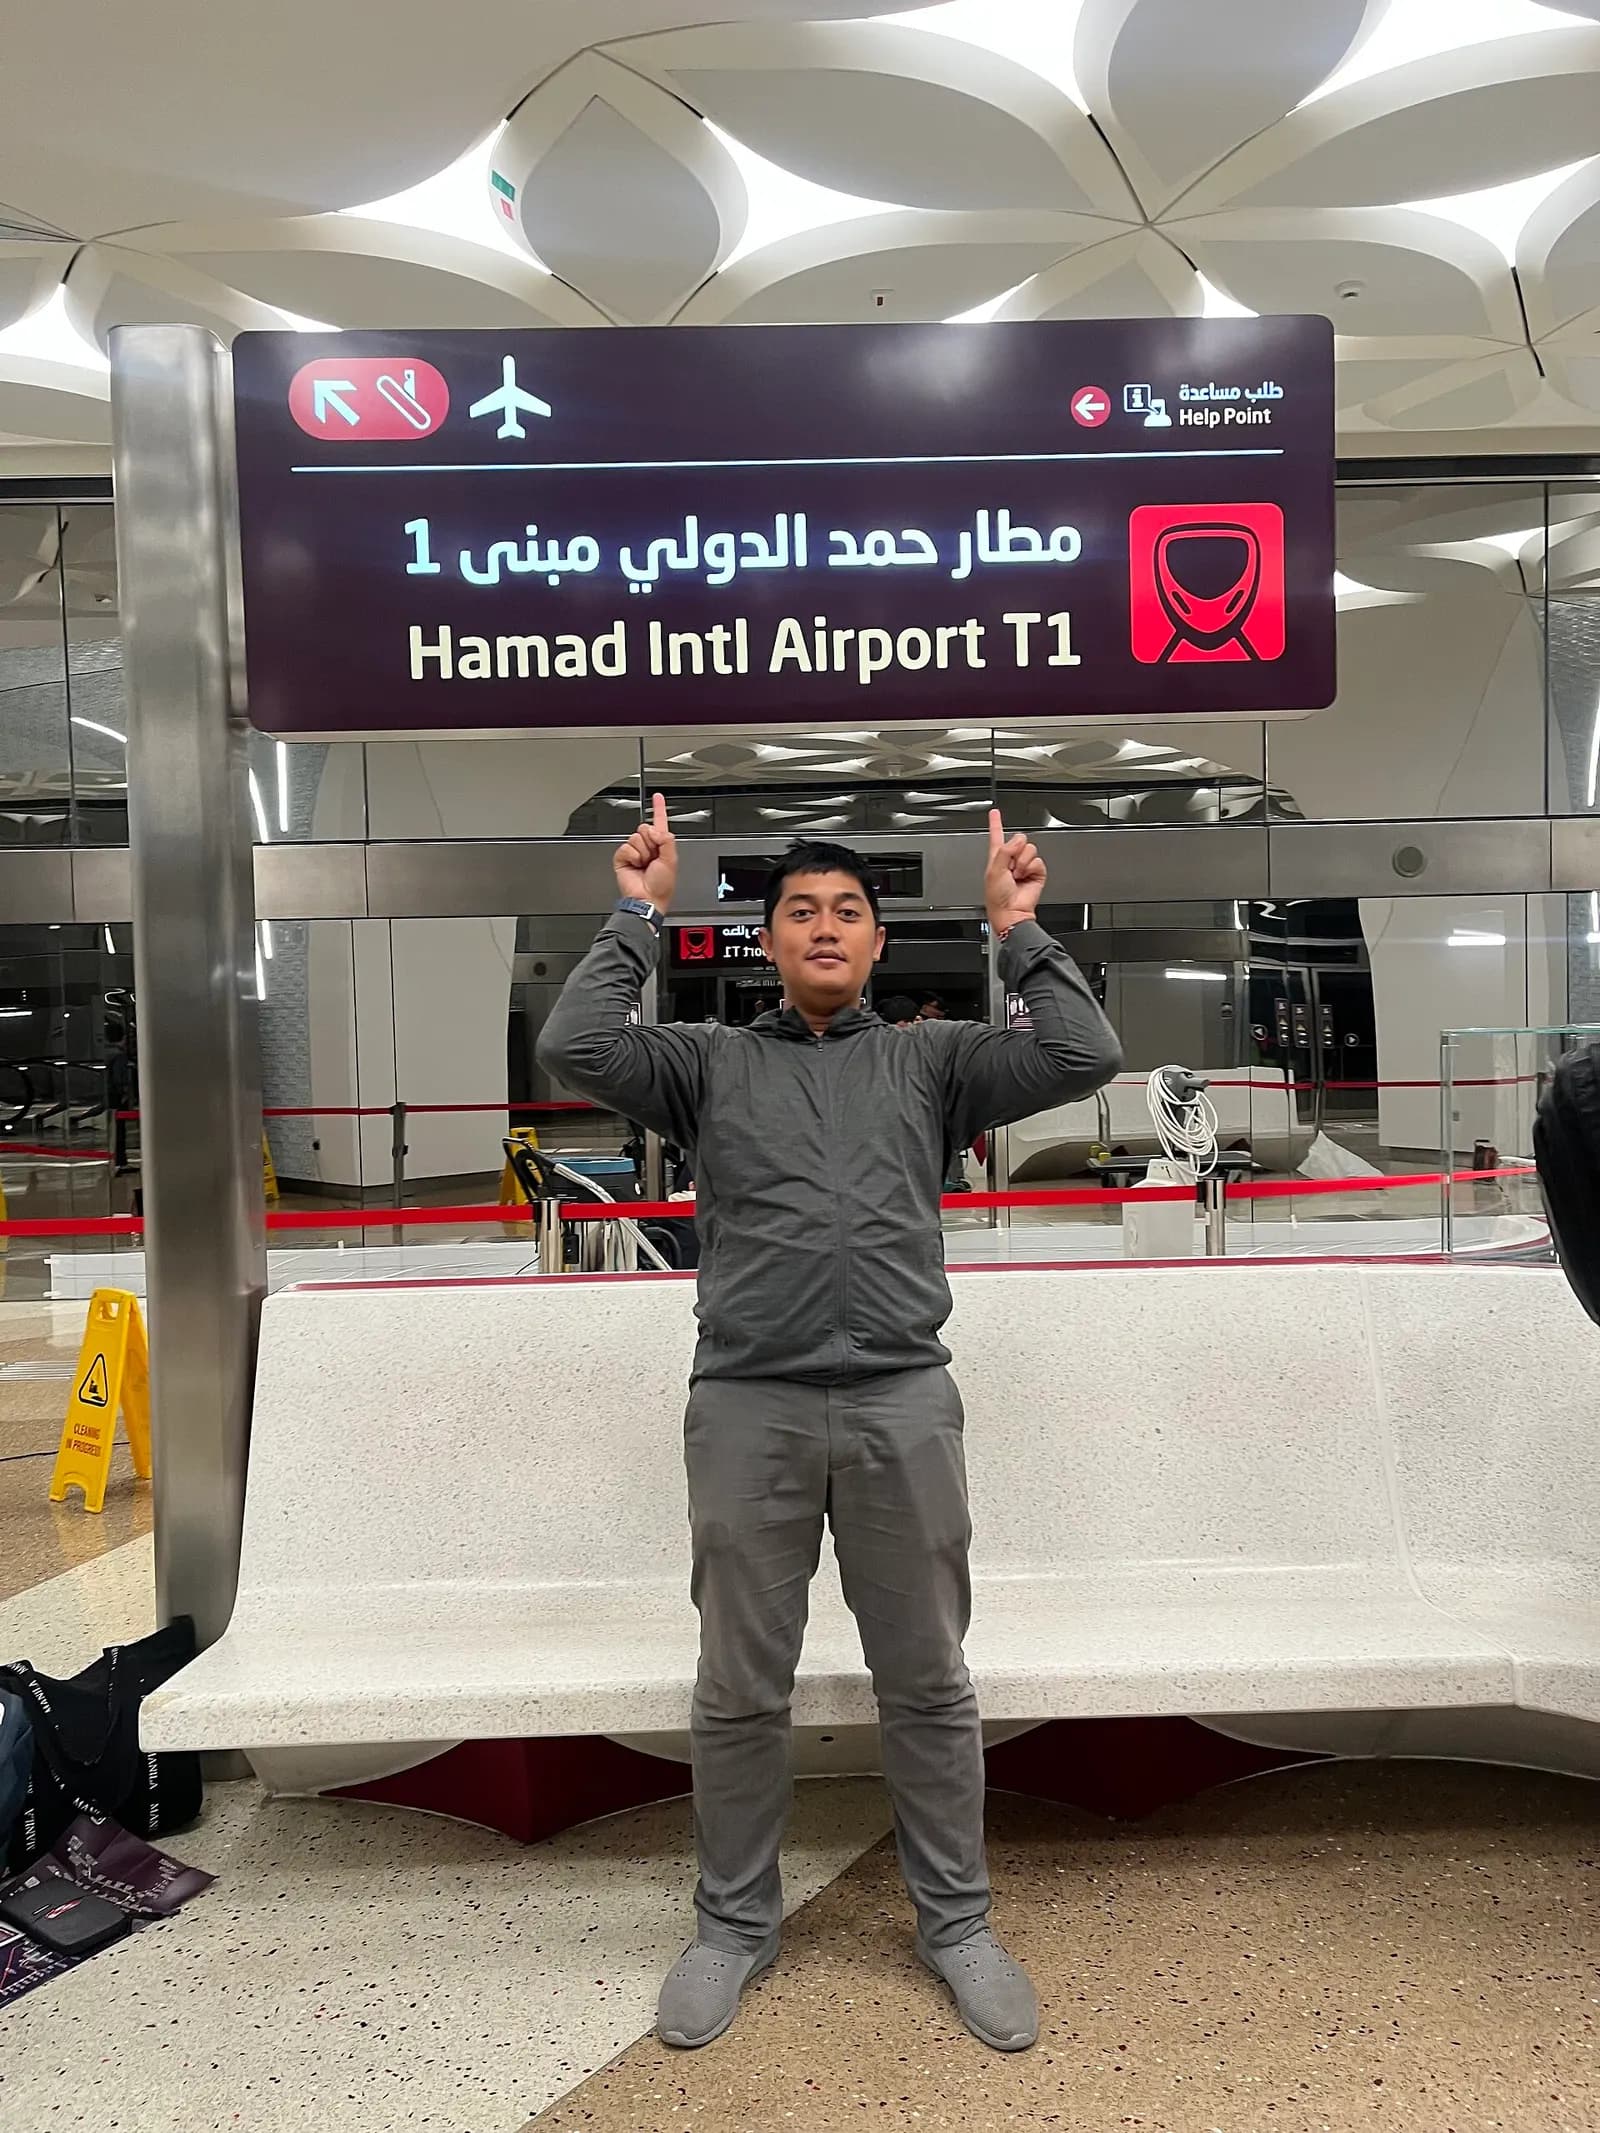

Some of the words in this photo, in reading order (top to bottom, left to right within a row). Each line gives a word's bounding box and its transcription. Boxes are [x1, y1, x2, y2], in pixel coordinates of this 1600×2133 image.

[1179, 382, 1241, 401] مساعدة
[1244, 381, 1284, 403] طلب
[1179, 408, 1220, 428] Help
[1224, 406, 1272, 425] Point
[404, 517, 442, 575] 1
[459, 524, 601, 586] مبنى
[619, 512, 808, 594] الدولي
[828, 529, 939, 567] حمد
[951, 508, 1083, 579] مطار
[408, 619, 627, 680] Hamad
[648, 617, 750, 676] Intl
[768, 615, 987, 685] Airport
[1002, 611, 1082, 668] T1
[28, 1679, 52, 1714] MANILA
